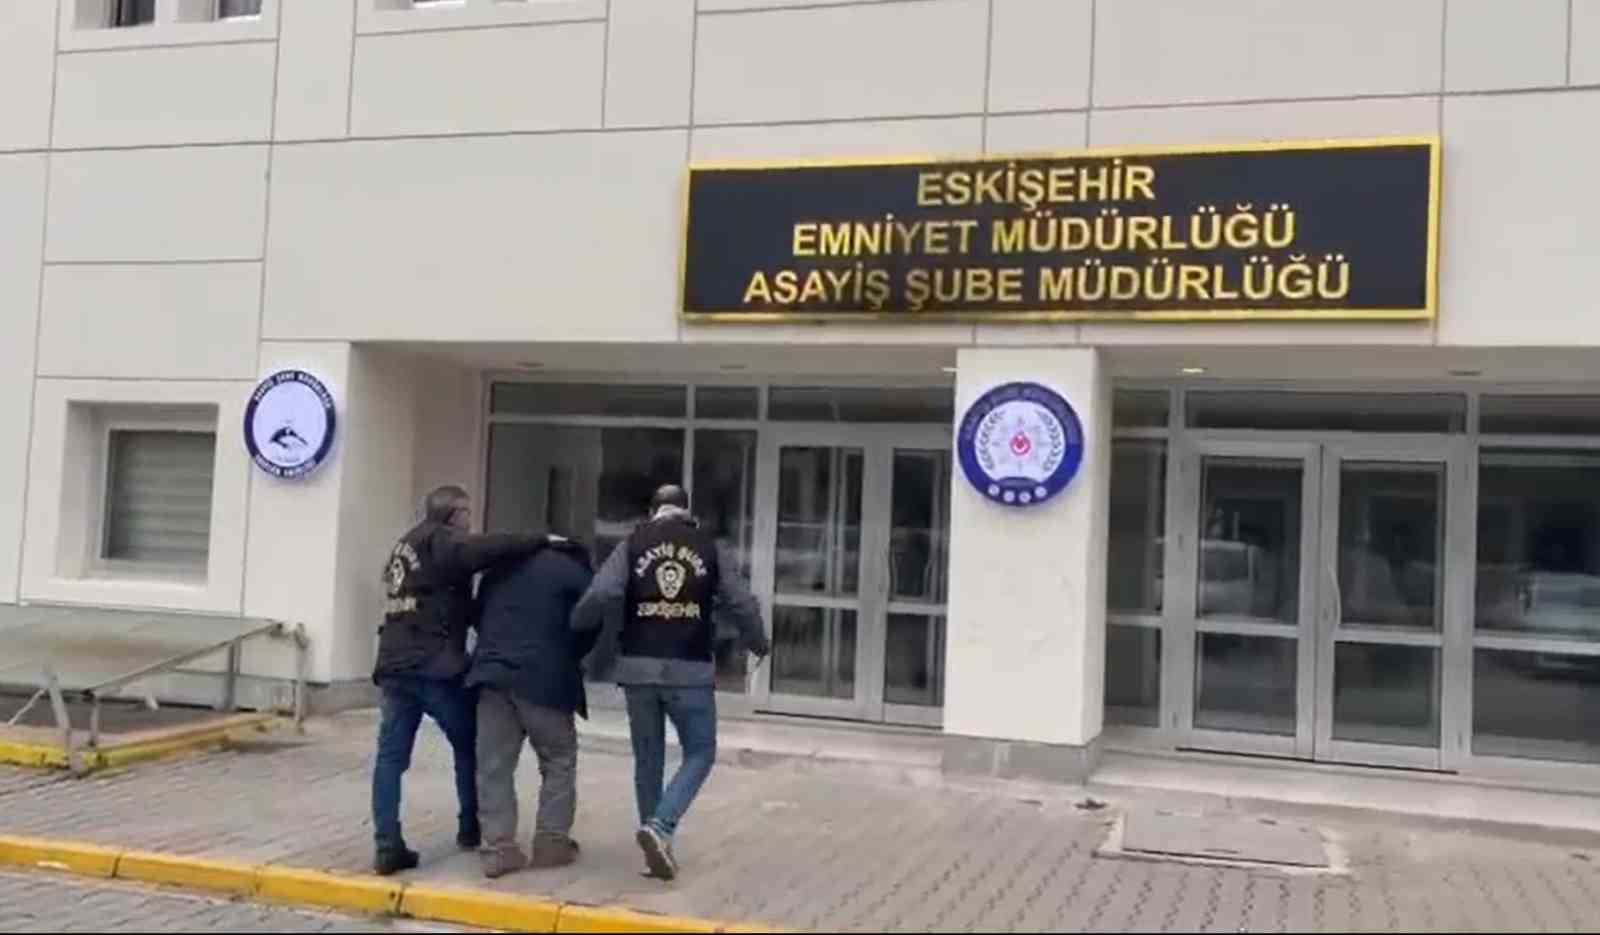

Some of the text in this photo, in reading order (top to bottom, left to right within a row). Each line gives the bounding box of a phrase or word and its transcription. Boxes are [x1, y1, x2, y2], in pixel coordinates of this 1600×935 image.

[917, 159, 1155, 211] ESKİŞEHİR
[793, 203, 1295, 256] EMNİYET MÜDÜRLÜĞÜ
[743, 253, 1350, 310] ASAYİŞ ŞUBE MÜDÜRLÜĞÜ
